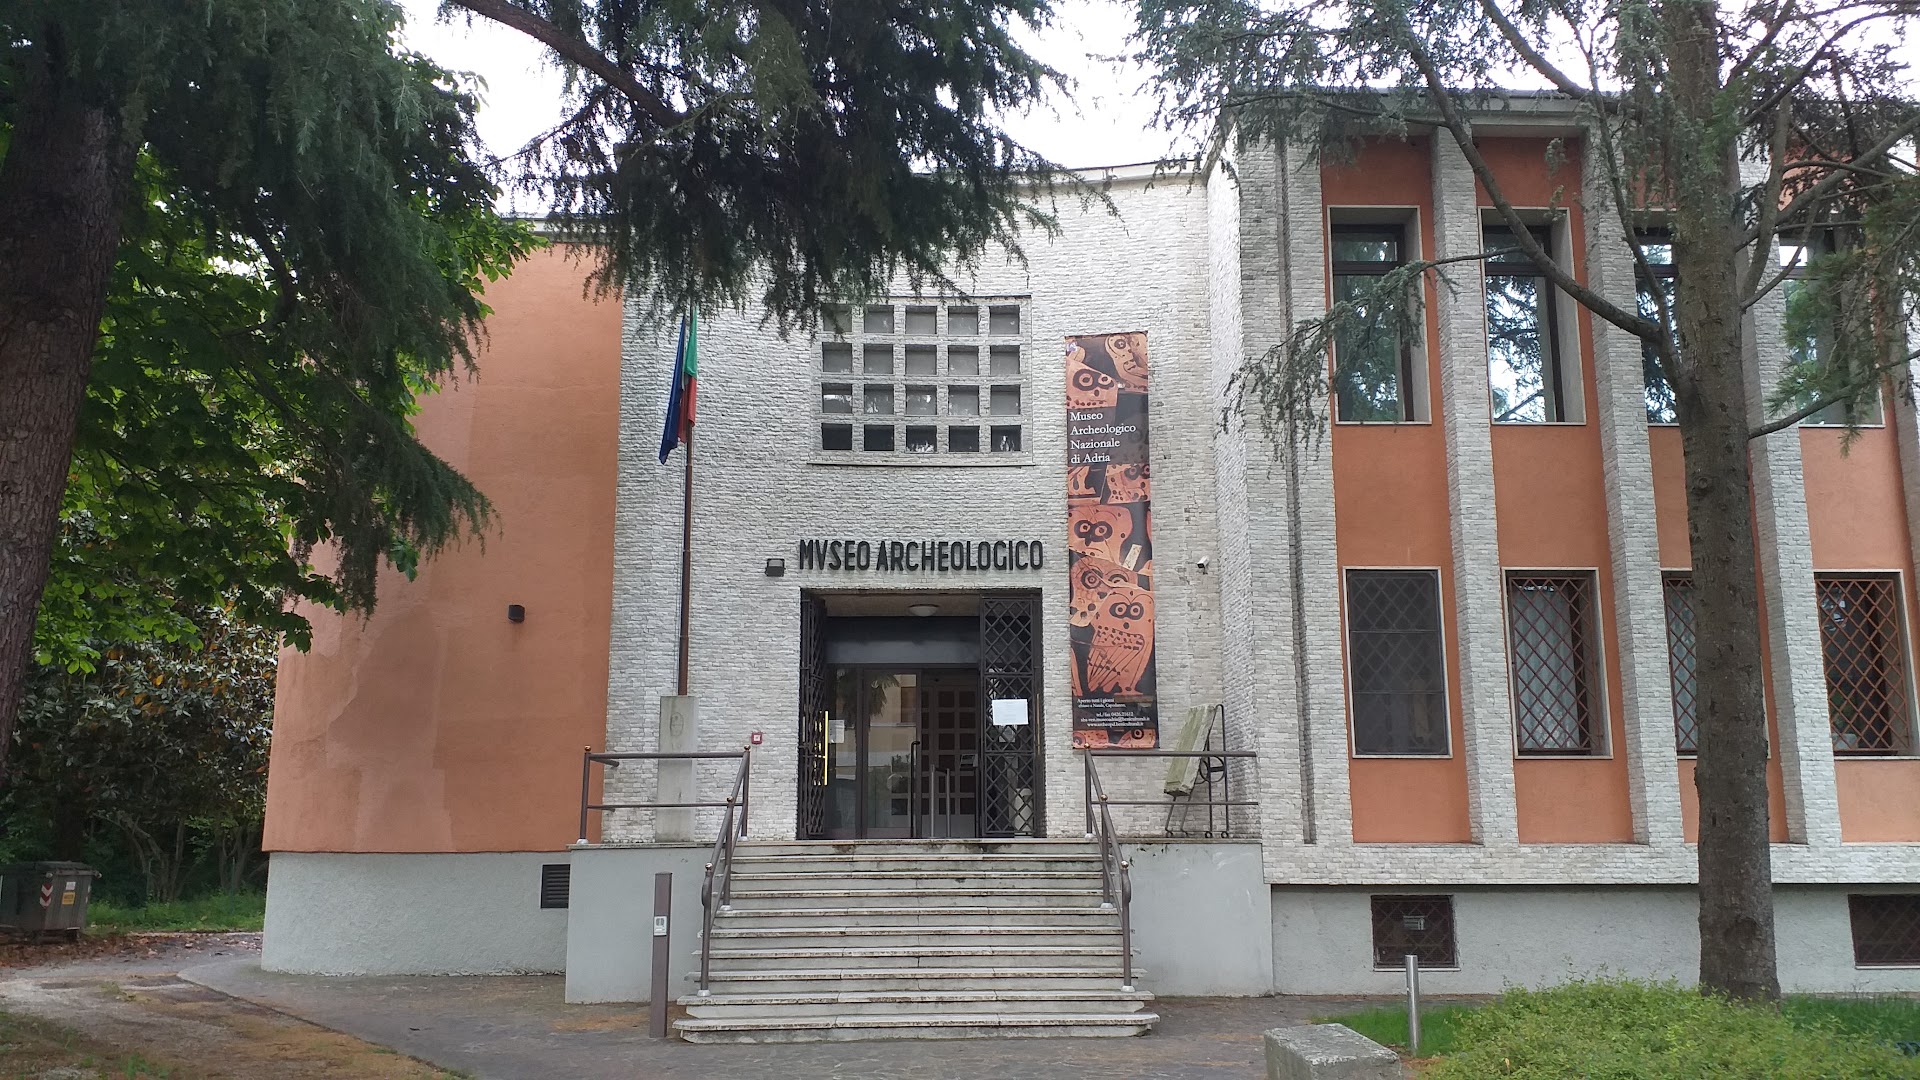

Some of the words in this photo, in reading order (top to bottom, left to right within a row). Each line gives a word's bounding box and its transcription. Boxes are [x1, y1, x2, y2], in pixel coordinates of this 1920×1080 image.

[1070, 412, 1103, 421] Museo
[1070, 423, 1136, 436] Archeologico
[1070, 438, 1120, 450] Nazionale
[1071, 454, 1080, 464] di
[1083, 452, 1110, 463] Adria
[876, 540, 1044, 572] ARCHEOLOGICO
